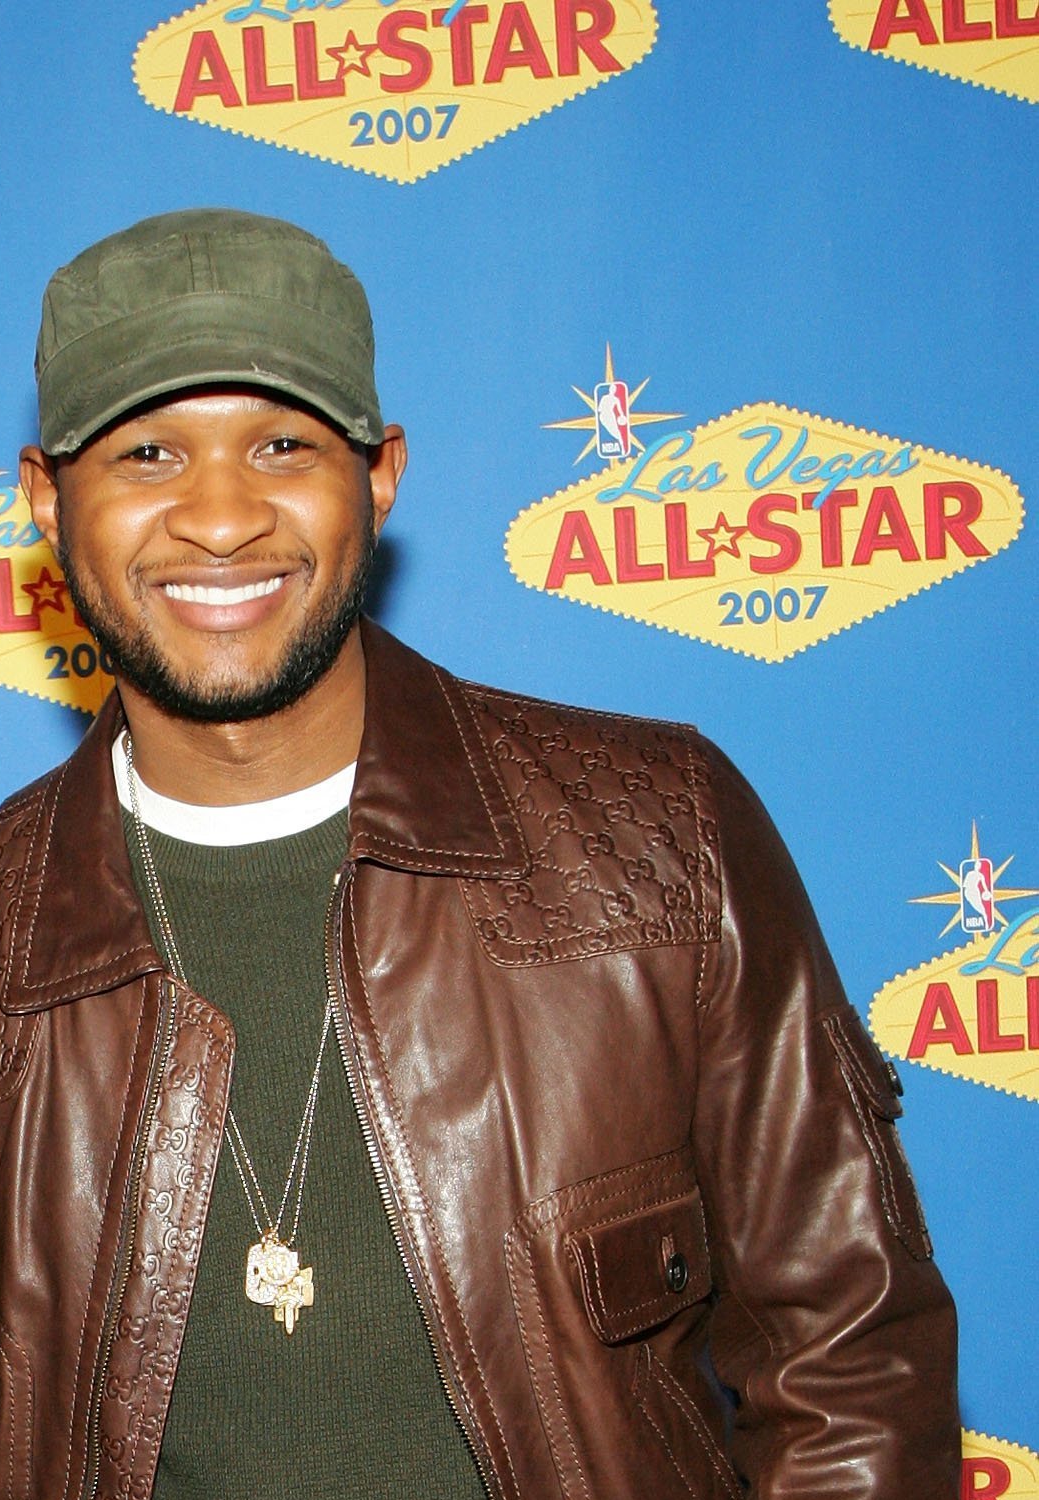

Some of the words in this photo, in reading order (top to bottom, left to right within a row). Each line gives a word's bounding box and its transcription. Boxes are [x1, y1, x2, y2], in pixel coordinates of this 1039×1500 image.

[173, 21, 346, 113] ALL
[376, 0, 625, 94] STAR
[348, 104, 460, 147] 2007
[596, 429, 727, 504] Las
[739, 425, 920, 511] Vegas
[545, 501, 716, 590] ALL
[747, 479, 992, 575] STAR
[718, 585, 829, 628] 2007
[965, 917, 985, 928] NBA
